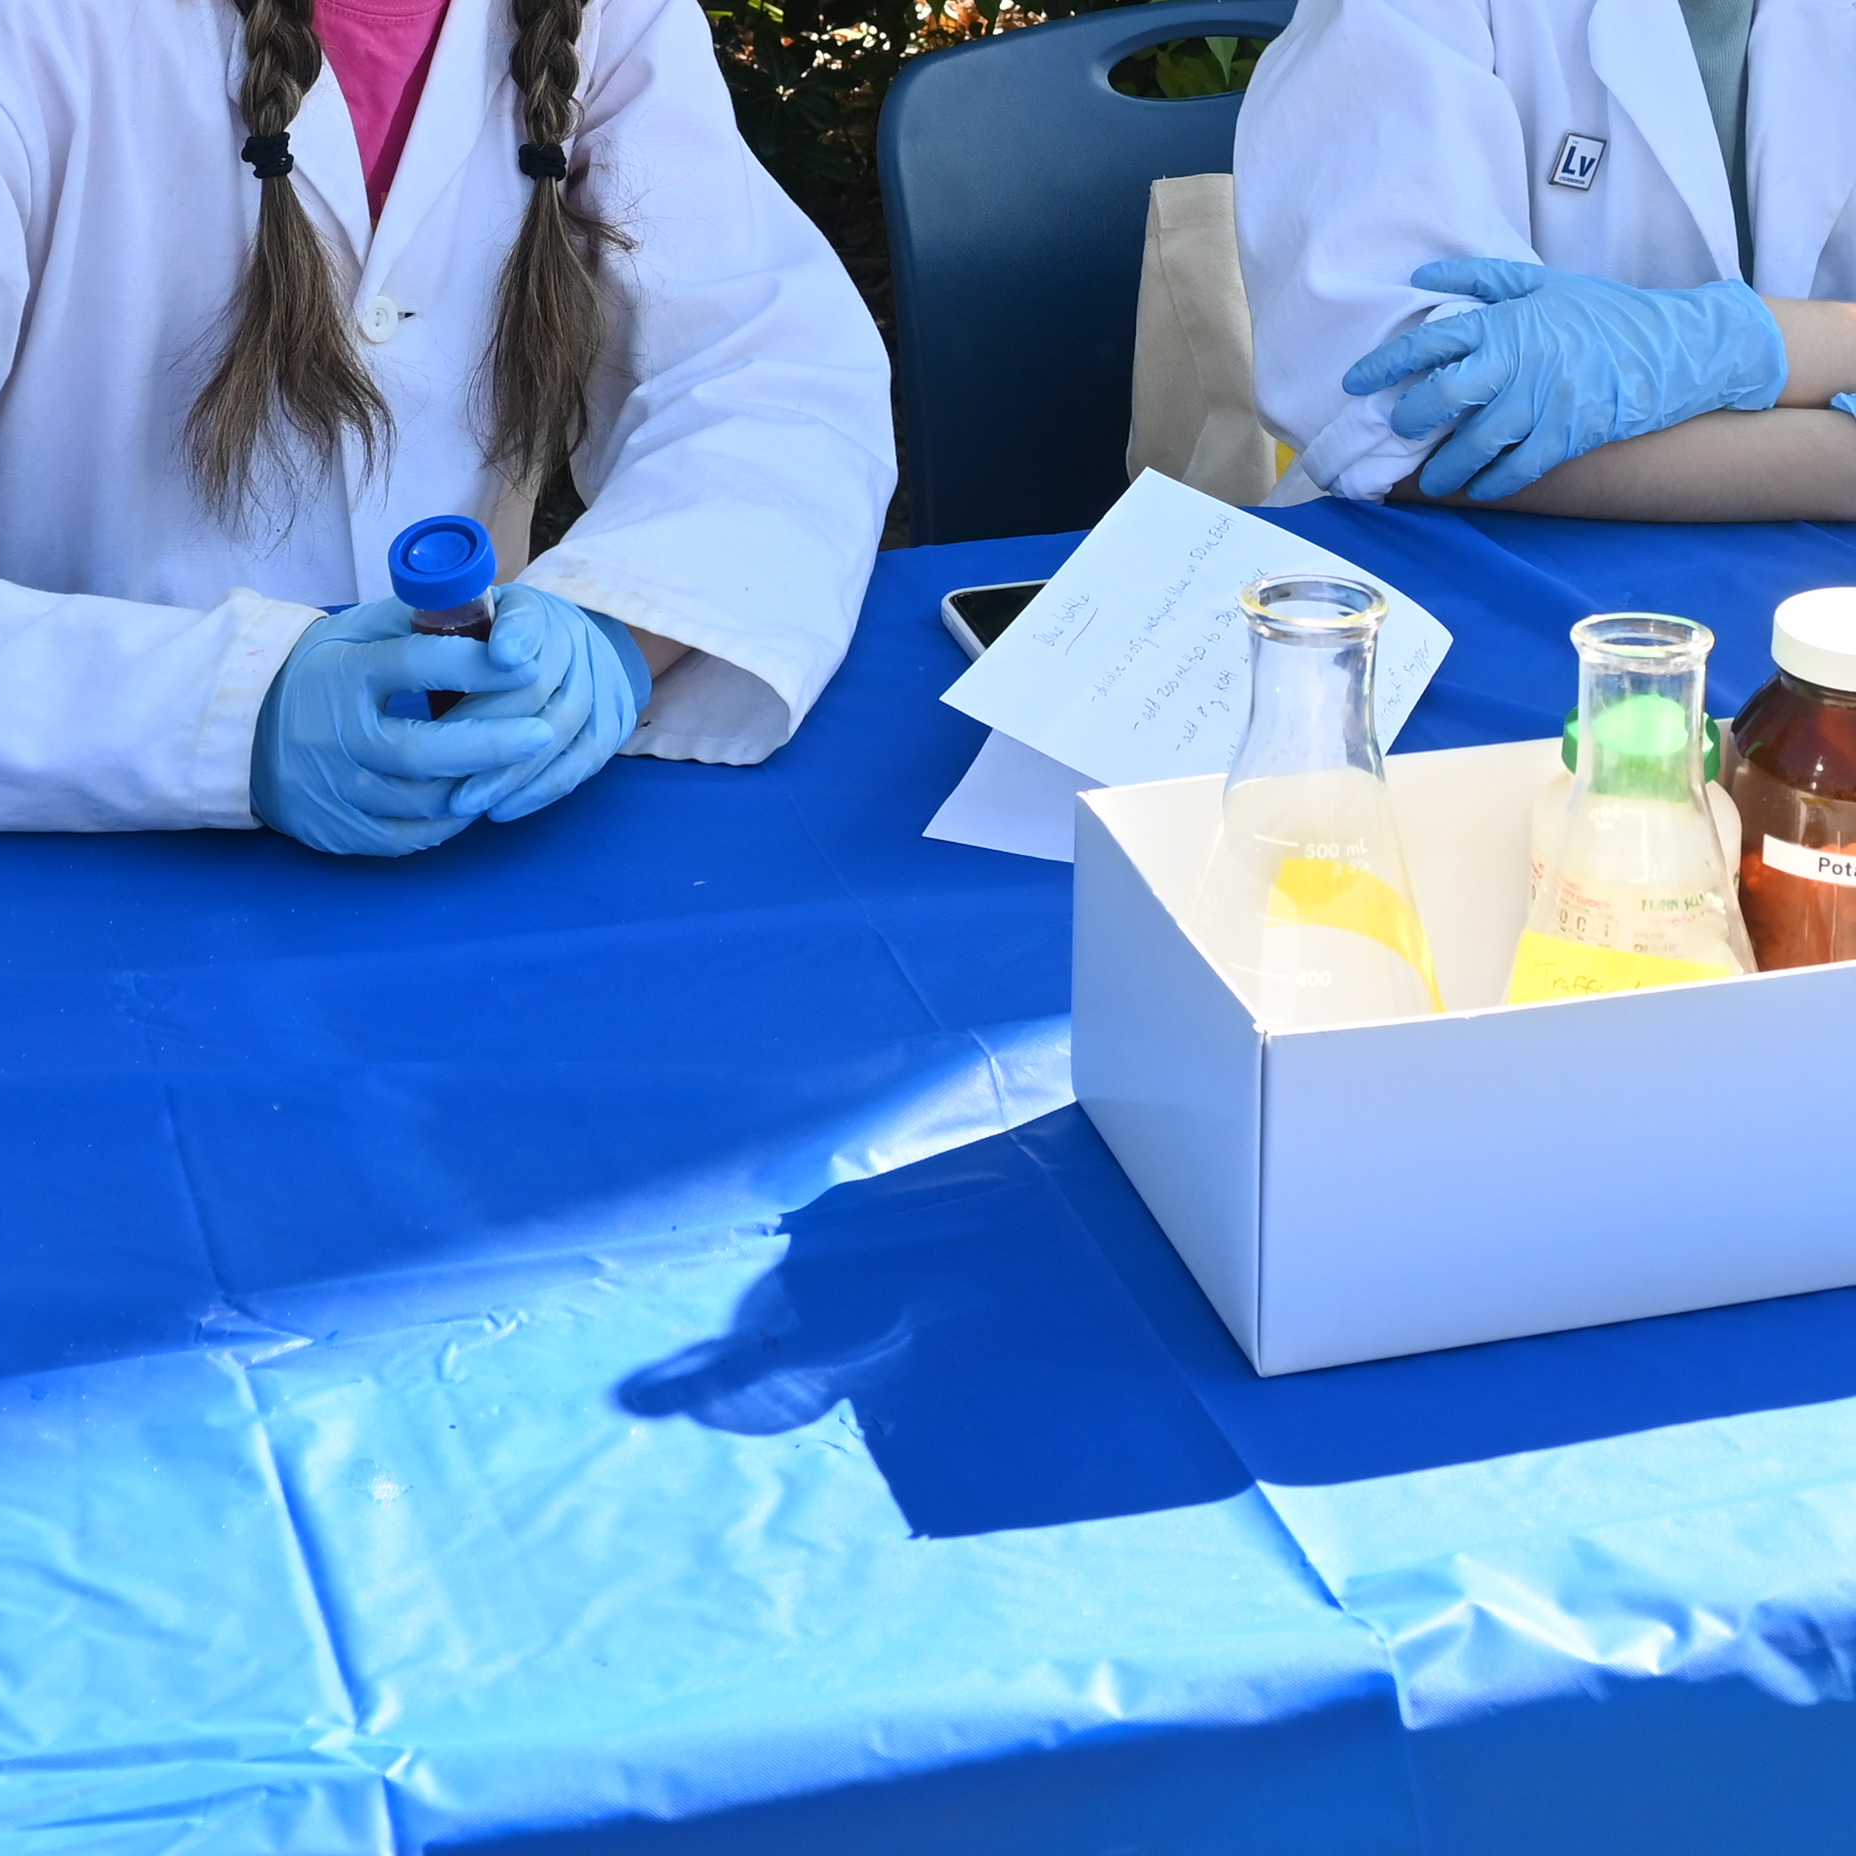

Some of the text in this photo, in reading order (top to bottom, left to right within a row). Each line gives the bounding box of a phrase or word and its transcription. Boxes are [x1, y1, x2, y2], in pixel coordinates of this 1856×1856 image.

[1561, 145, 1597, 178] Lv
[1303, 837, 1368, 860] 500 mL
[1295, 970, 1333, 988] 400
